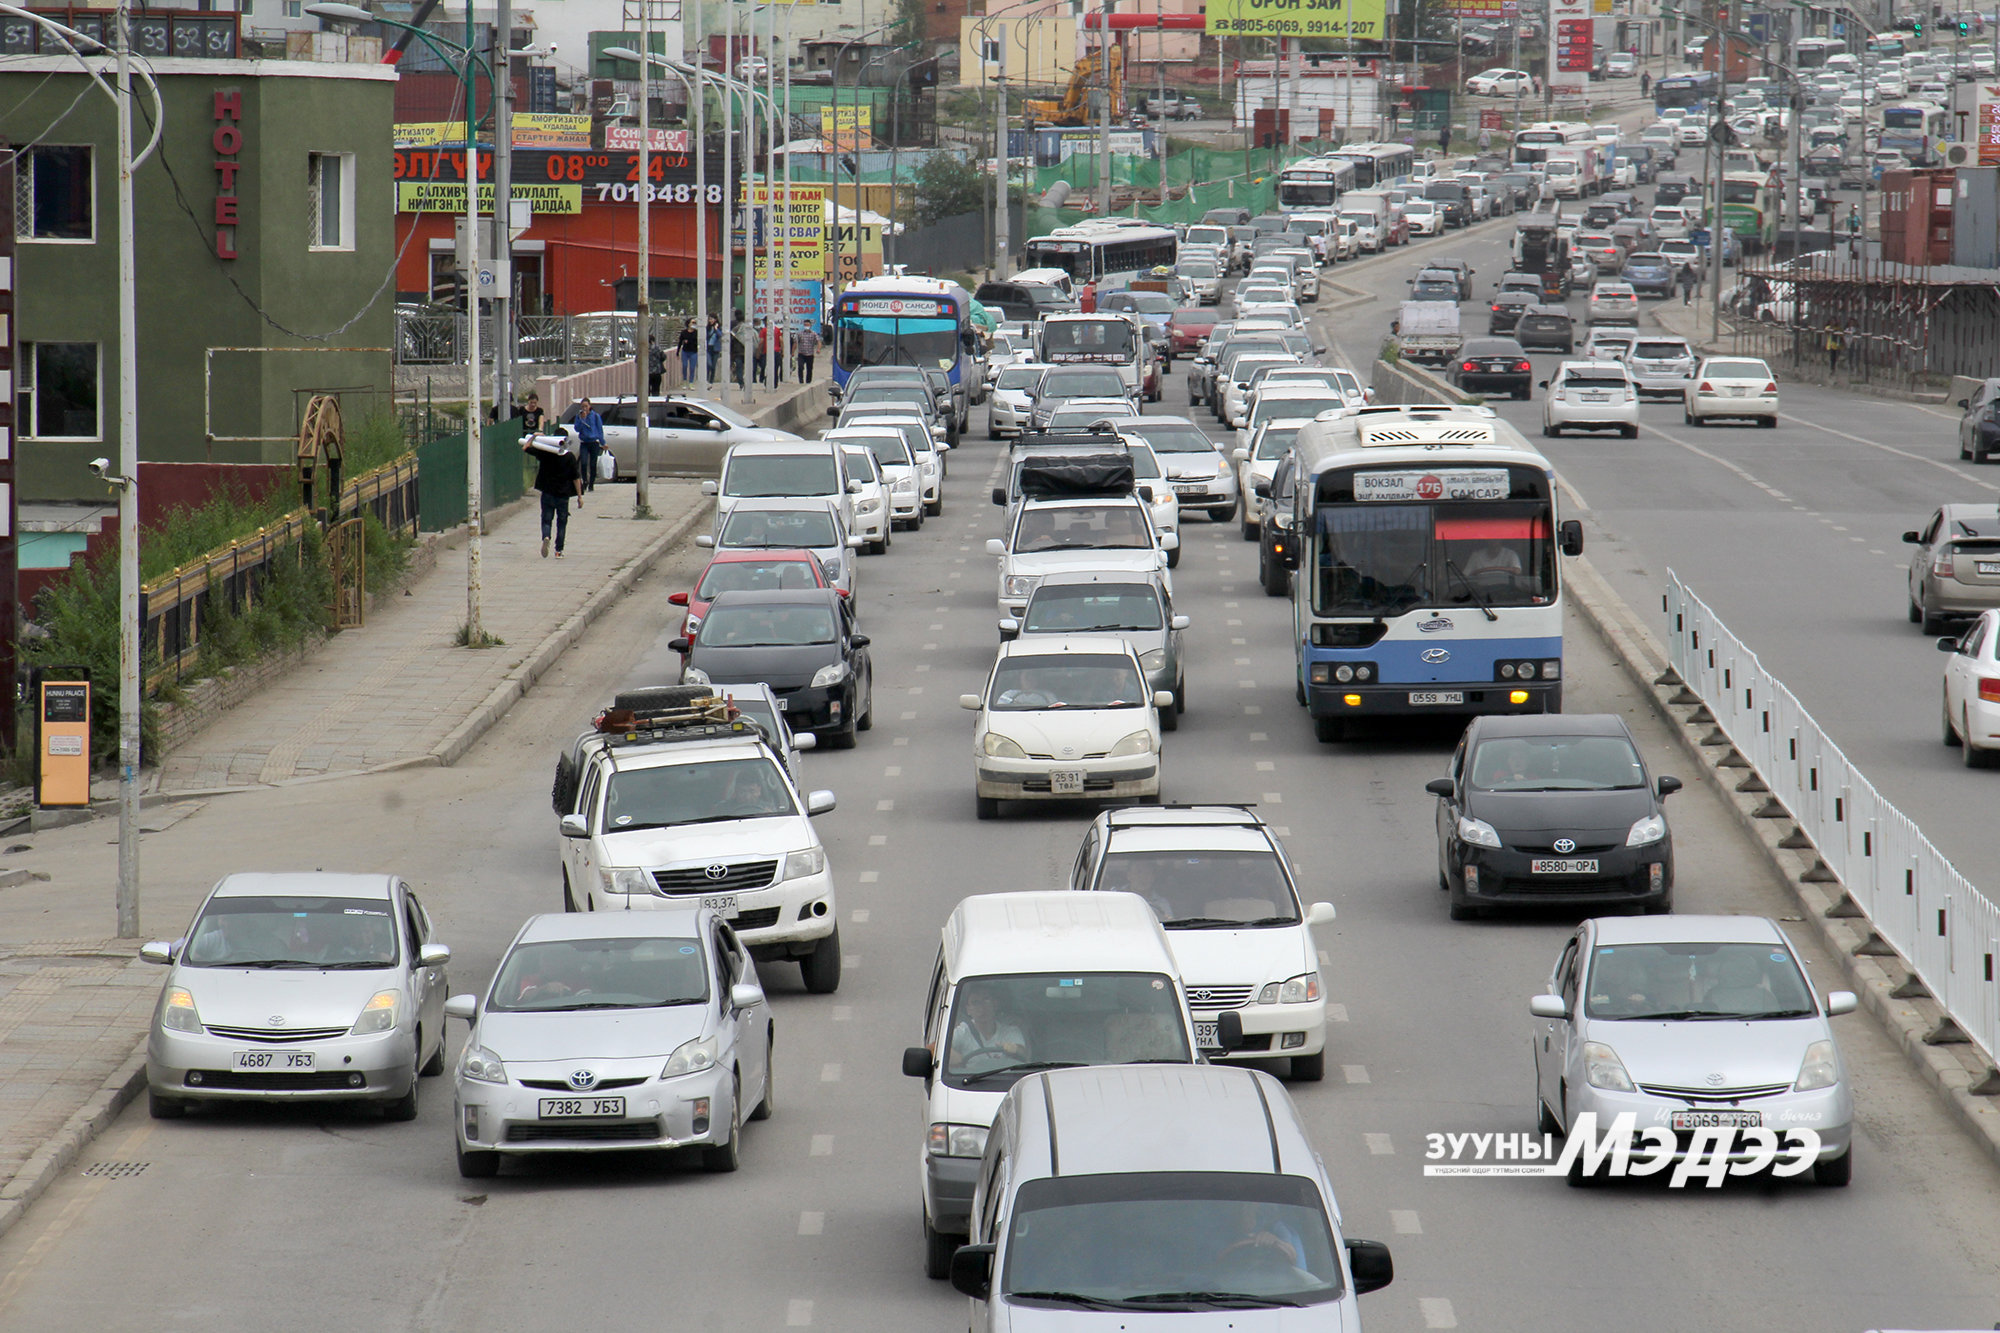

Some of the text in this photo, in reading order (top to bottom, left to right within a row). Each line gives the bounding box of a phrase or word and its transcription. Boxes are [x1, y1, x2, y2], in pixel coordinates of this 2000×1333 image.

[142, 27, 167, 50] 33
[174, 28, 200, 49] 32
[208, 32, 230, 51] 31
[531, 115, 589, 124] АМОРТИЗАТОР
[393, 128, 435, 137] ОРТИЗАТОР
[516, 134, 588, 143] СТАРТЕР ЖАНАМ
[393, 152, 492, 179] ЭЛГҮҮ
[214, 91, 242, 260] HOTEL
[408, 199, 453, 211] НИМГЭН
[755, 260, 799, 268] СЕВС
[861, 301, 889, 309] МОНЕЛ
[1364, 478, 1404, 488] ВОКЗАЛ
[1450, 488, 1500, 499] САНСАР
[65, 689, 85, 697] PALACE
[1413, 694, 1438, 703] 0559
[1055, 772, 1079, 783] 2591
[1540, 861, 1568, 872] 8580
[1197, 1024, 1219, 1036] 397
[240, 1054, 312, 1068] 4687 УБЗ
[547, 1100, 619, 1114] 7382 УБЗ
[1684, 1114, 1720, 1128] 3069
